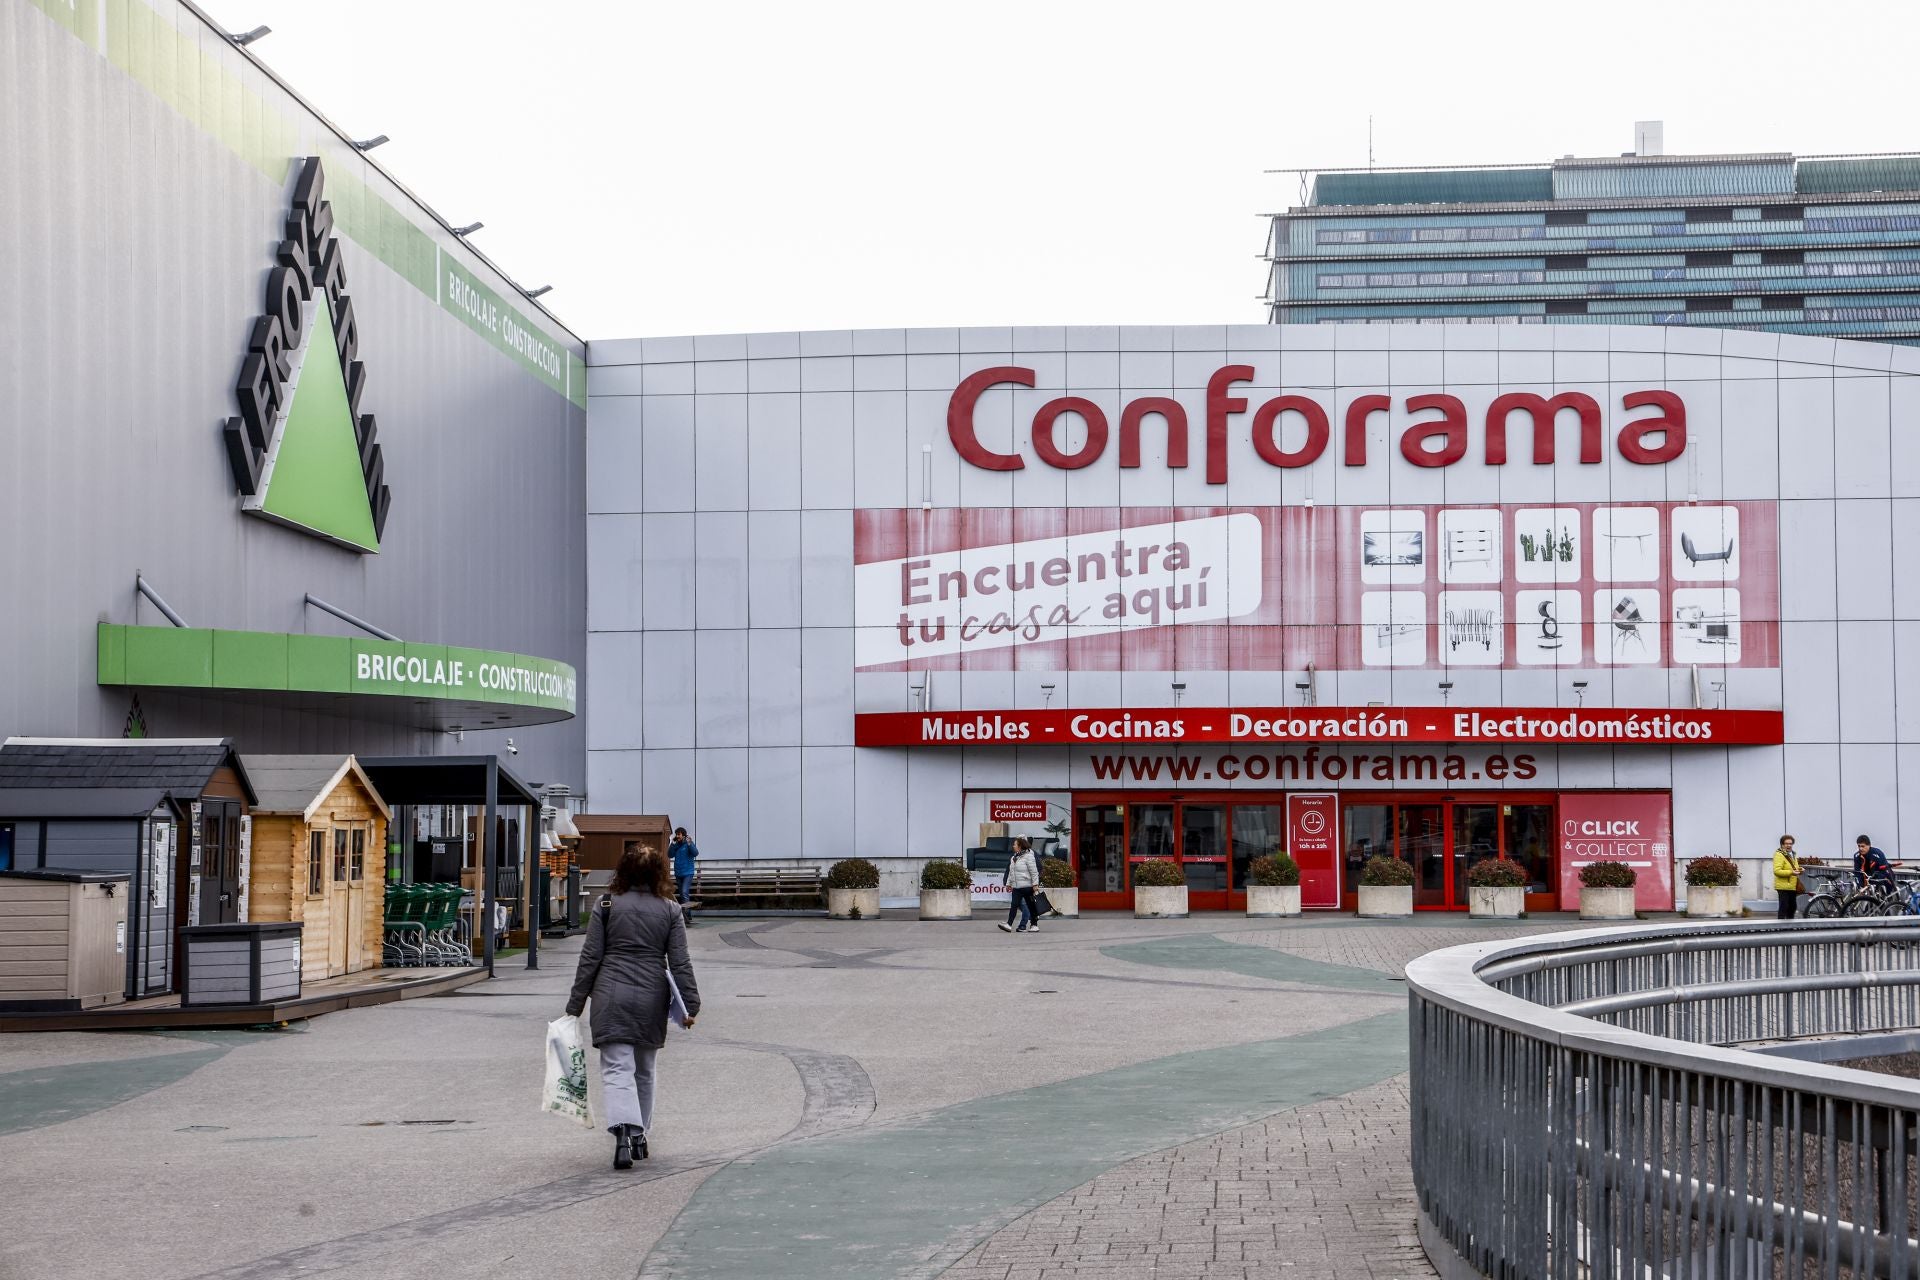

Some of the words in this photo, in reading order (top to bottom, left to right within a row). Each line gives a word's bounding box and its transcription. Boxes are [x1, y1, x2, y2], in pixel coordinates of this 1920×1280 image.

[225, 207, 314, 496] LEROY
[293, 156, 392, 544] MERLIN
[449, 271, 497, 333] BRICOLAJE
[503, 315, 561, 380] CONSTRUCCIÓN
[946, 364, 1687, 485] Conforama
[901, 540, 1190, 607] Encuentra
[896, 611, 946, 647] tu
[959, 604, 1092, 642] casa
[1102, 566, 1212, 625] aquí
[357, 653, 464, 686] BRICOLAJE
[478, 663, 563, 699] CONSTRUCCIÓN
[922, 715, 1030, 740] Muebles
[1070, 713, 1185, 739] Cocinas
[1230, 713, 1408, 738] Decoración
[1454, 713, 1712, 740] Electrodomésticos
[1091, 747, 1537, 781] www.conforama.es
[994, 809, 1042, 818] Conforama
[1581, 820, 1639, 836] CLICK
[1576, 843, 1646, 857] COLLECT
